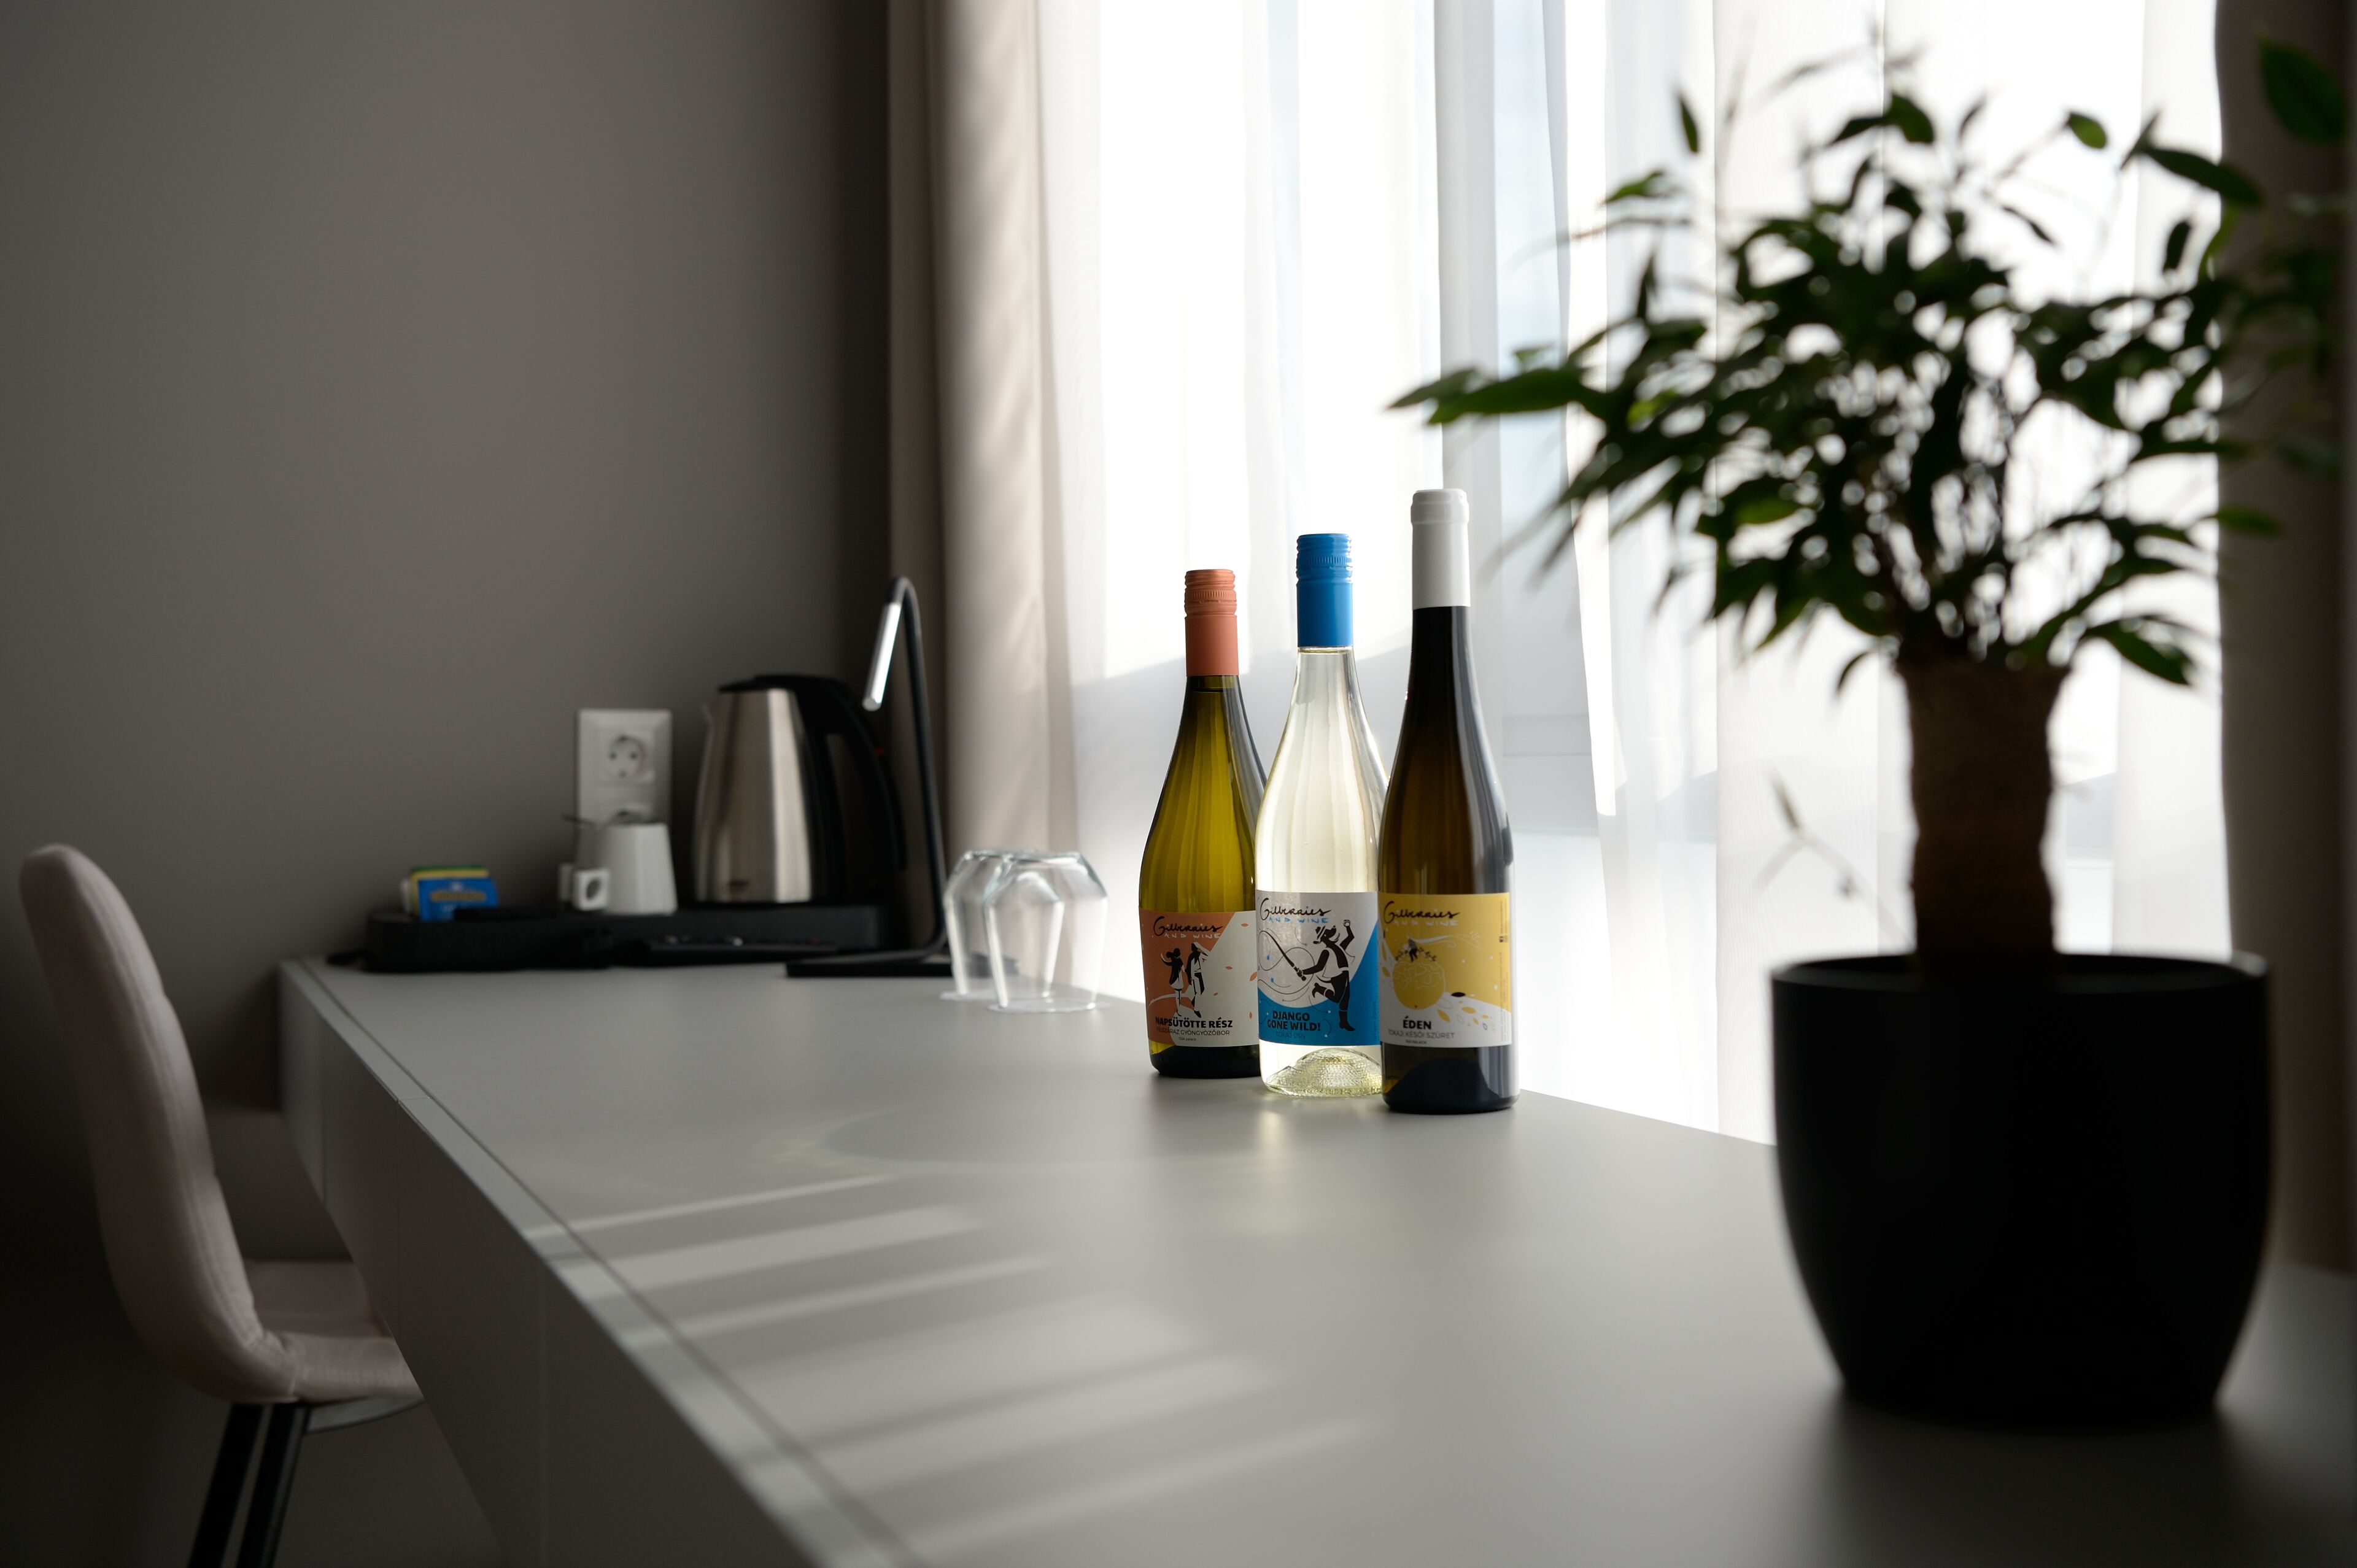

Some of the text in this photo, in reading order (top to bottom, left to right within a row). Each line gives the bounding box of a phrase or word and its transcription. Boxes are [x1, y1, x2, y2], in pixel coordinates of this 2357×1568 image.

[1272, 1010, 1310, 1021] DJANGO
[1155, 1016, 1233, 1029] NAPSÜTÖTTE RÉSZ
[1267, 1019, 1321, 1031] GONE WILD!
[1403, 1016, 1431, 1030] ÉDEN
